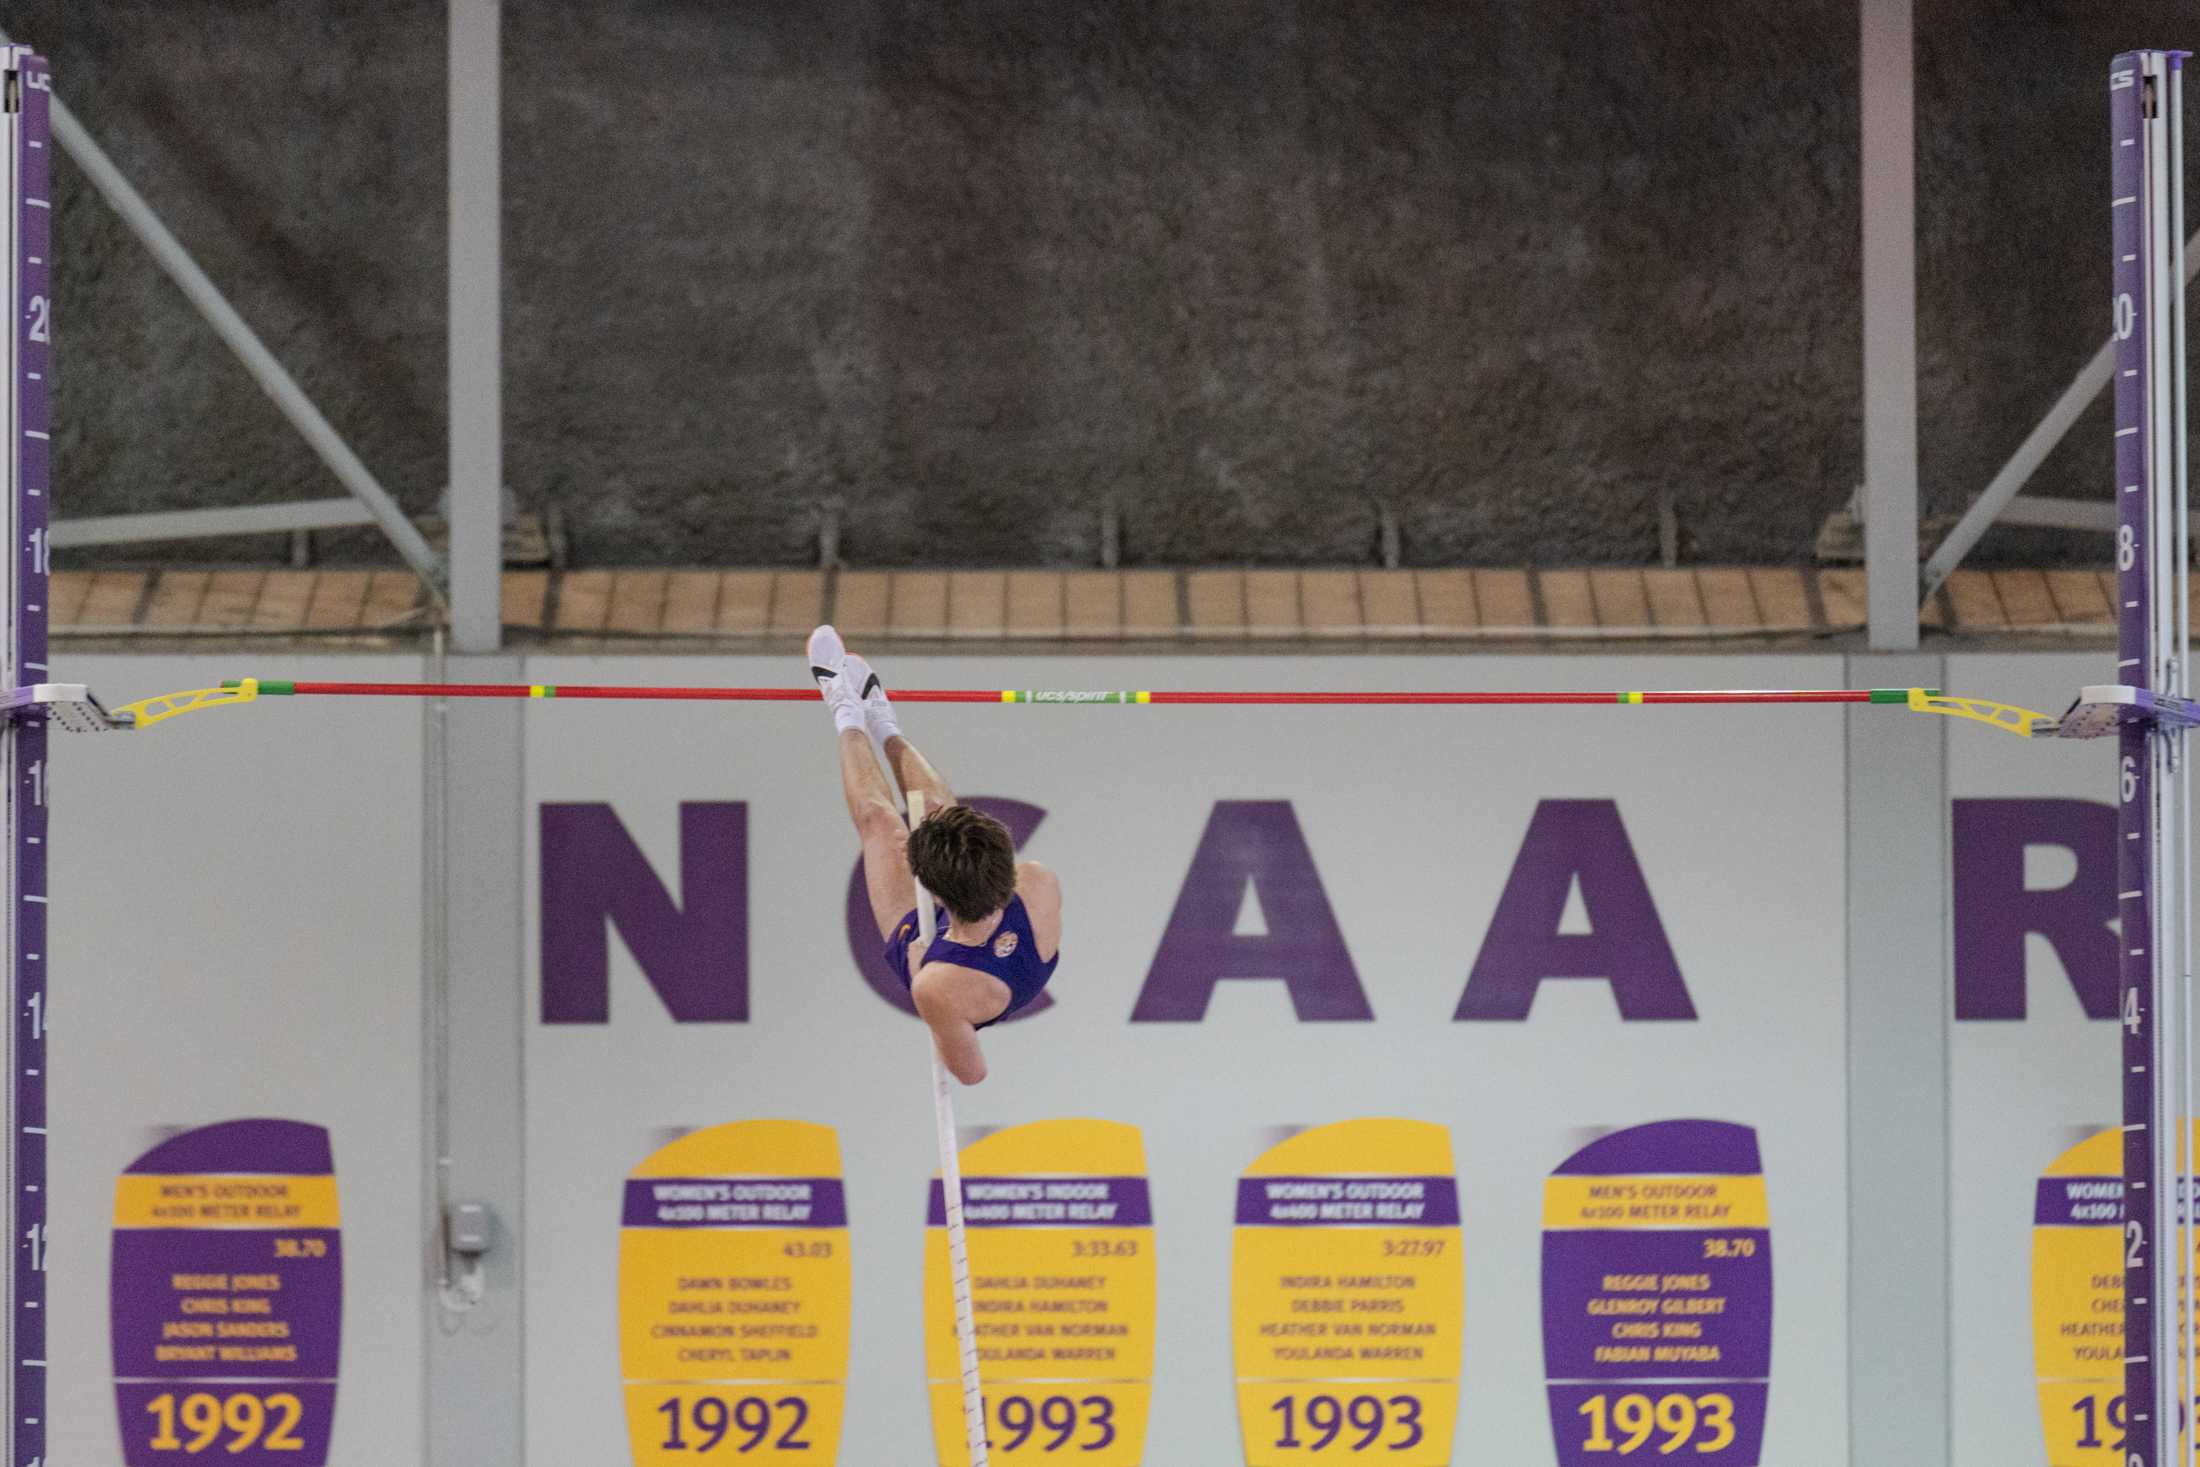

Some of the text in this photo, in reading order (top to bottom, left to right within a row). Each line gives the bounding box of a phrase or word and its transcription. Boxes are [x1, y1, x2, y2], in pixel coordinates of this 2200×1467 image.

[540, 799, 1697, 1024] NCAA
[1642, 1184, 1718, 1200] OUTDOOR
[705, 1203, 761, 1221] METER
[762, 1203, 813, 1221] RELAY
[1011, 1203, 1066, 1220] METER
[1067, 1203, 1118, 1220] RELAY
[1319, 1202, 1374, 1220] METER
[1375, 1202, 1425, 1220] RELAY
[1629, 1204, 1680, 1219] METER
[1685, 1204, 1732, 1219] RELAY
[1660, 1273, 1711, 1292] JONES
[147, 1392, 305, 1454] 1992
[657, 1396, 811, 1453] 1992
[1271, 1394, 1424, 1452] 1993
[1578, 1393, 1737, 1456] 1993
